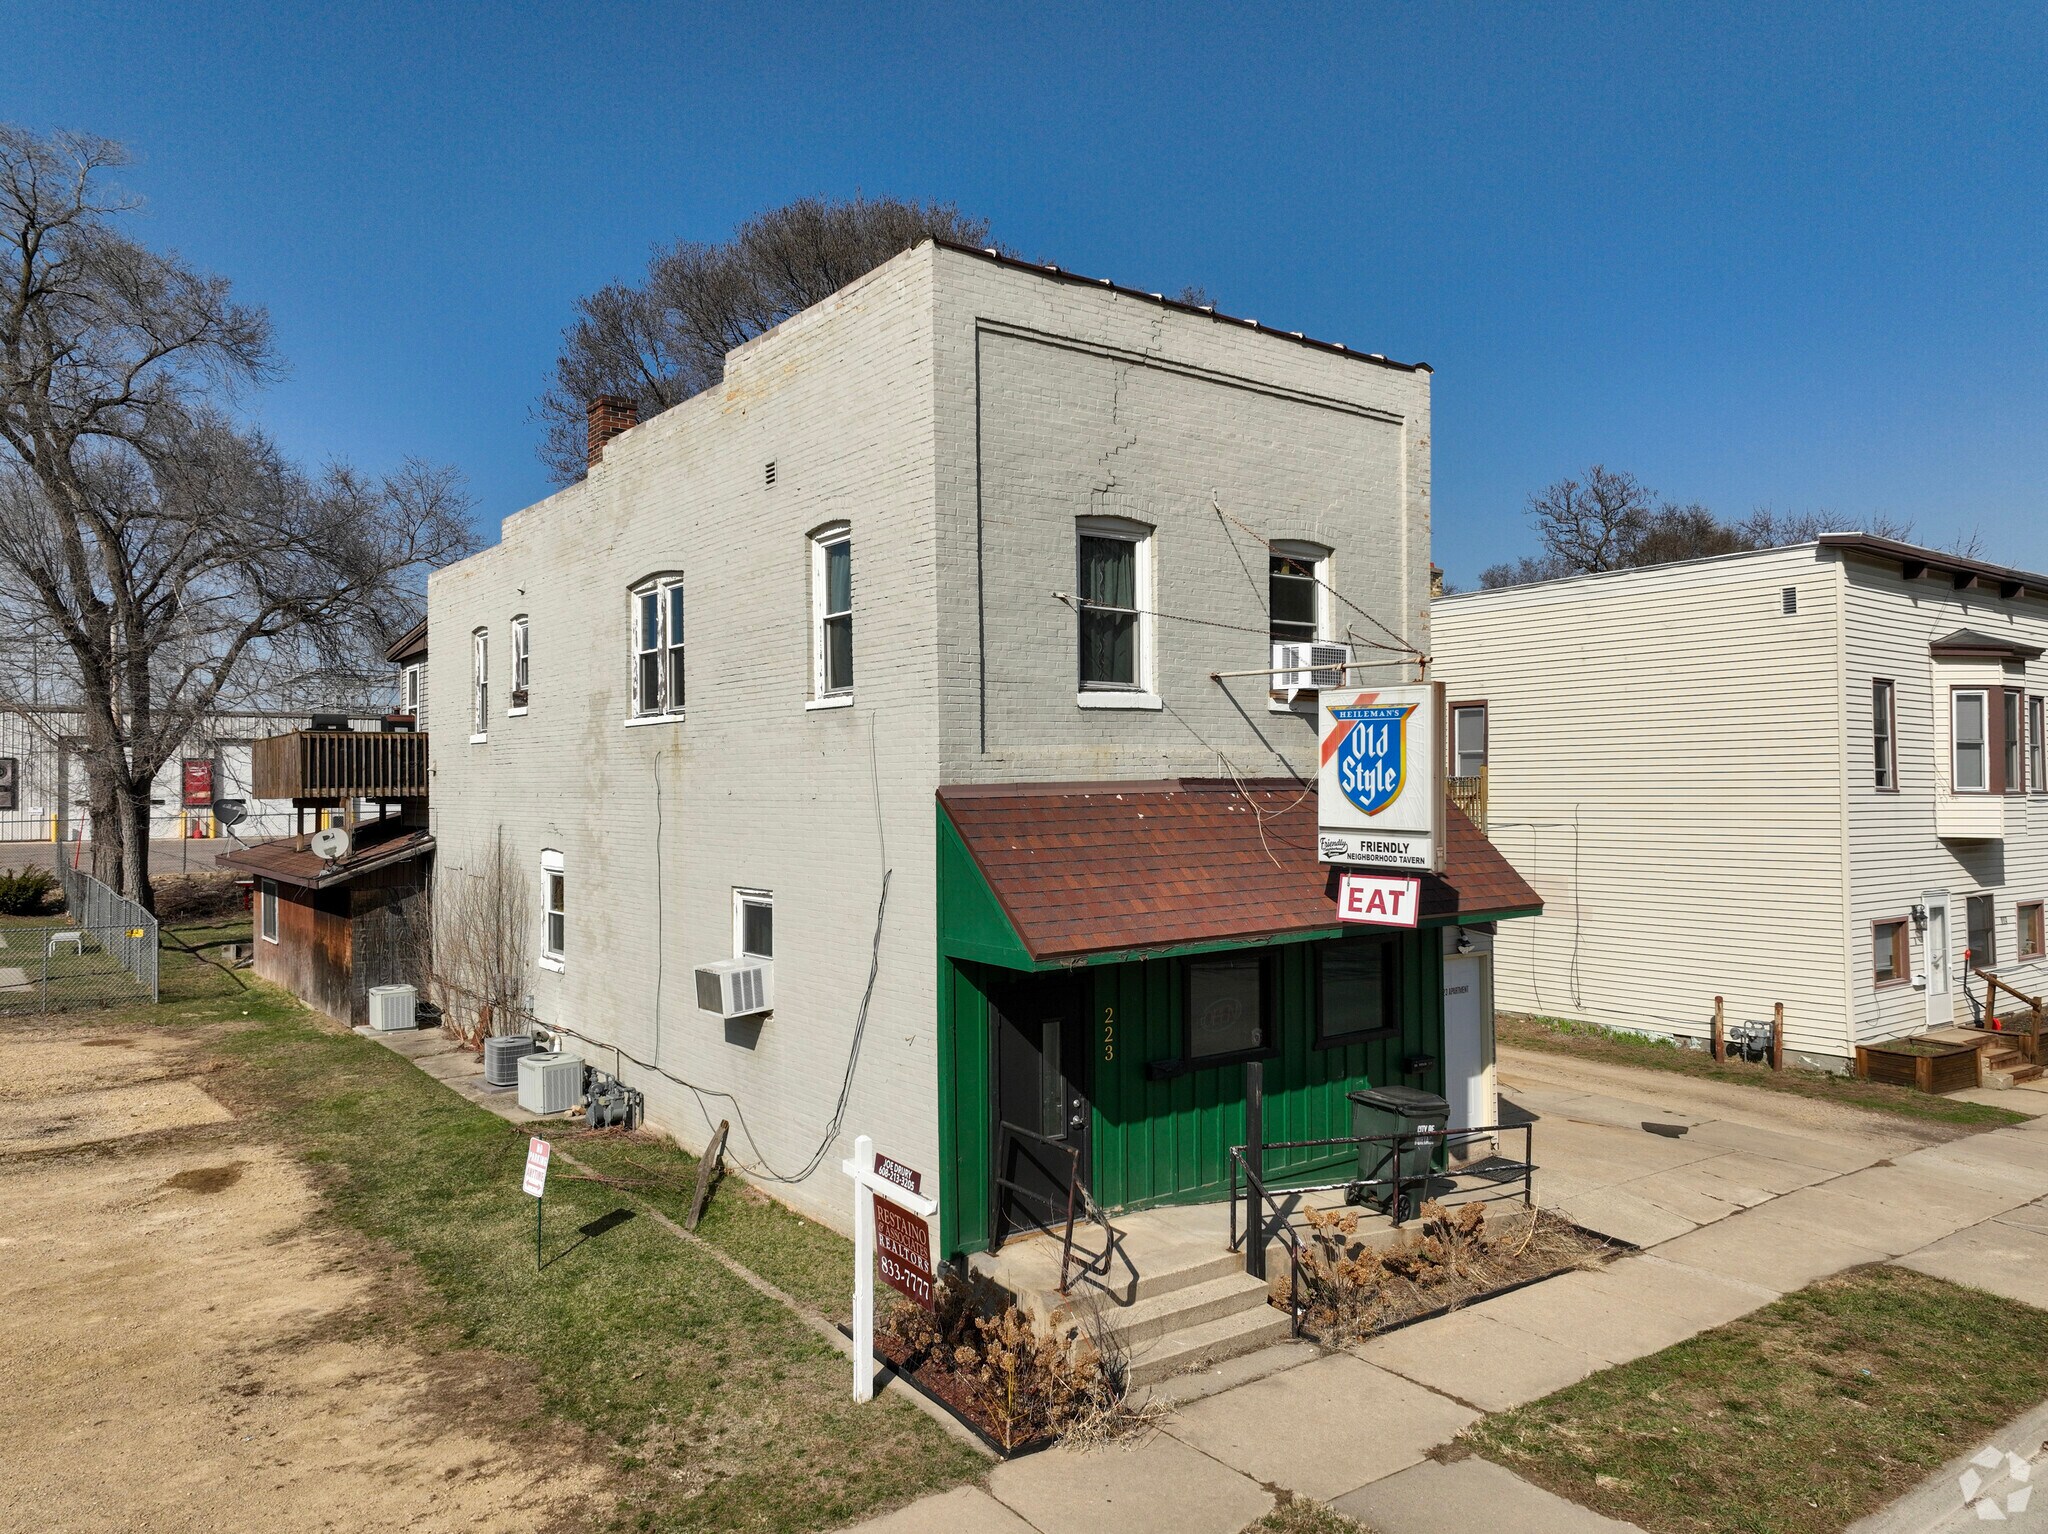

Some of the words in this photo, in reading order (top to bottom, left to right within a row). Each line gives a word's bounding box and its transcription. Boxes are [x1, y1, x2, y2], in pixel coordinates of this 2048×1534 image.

[1339, 709, 1400, 718] HEILEMAN'S
[1352, 722, 1388, 760] Old
[1341, 758, 1396, 806] Style
[1346, 852, 1398, 863] NEIGHBORHOOD
[1399, 855, 1425, 865] TAVERN
[1360, 840, 1410, 854] FRIENDLY
[1347, 887, 1405, 916] EAT
[1104, 1007, 1114, 1061] 223
[878, 1165, 915, 1191] 608-213-3205
[883, 1158, 894, 1171] JOE
[894, 1163, 913, 1180] DRURY
[877, 1205, 927, 1245] RESTAINO
[885, 1225, 928, 1259] ASSOCIATES
[879, 1232, 929, 1274] REALTORS
[881, 1255, 930, 1300] 833-7777
